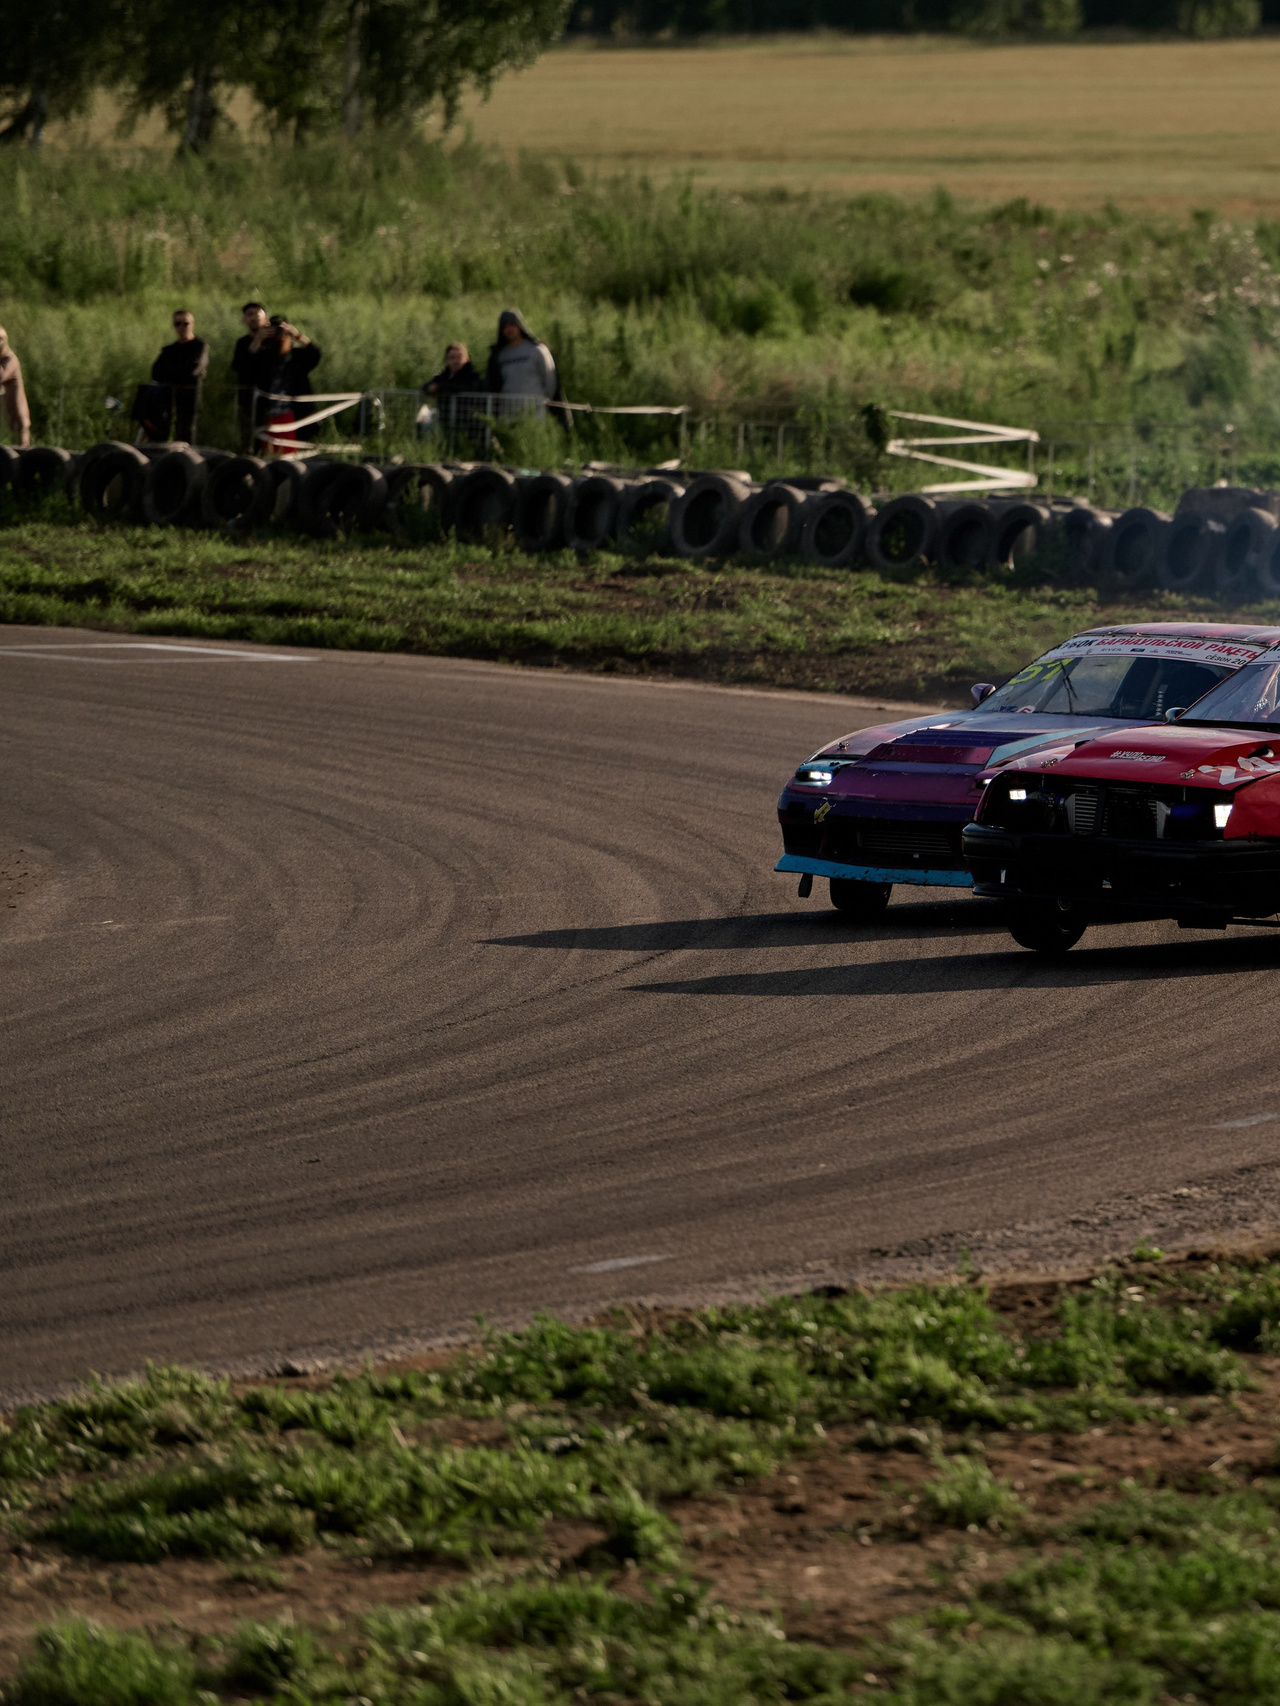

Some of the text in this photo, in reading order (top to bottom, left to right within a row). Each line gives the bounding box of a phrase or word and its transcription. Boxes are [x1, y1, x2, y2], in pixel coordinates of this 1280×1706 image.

[1056, 639, 1098, 649] УБОК
[1095, 638, 1206, 650] БАРНАУЛЬСКОЙ
[1205, 654, 1246, 666] СЕЗОН 20
